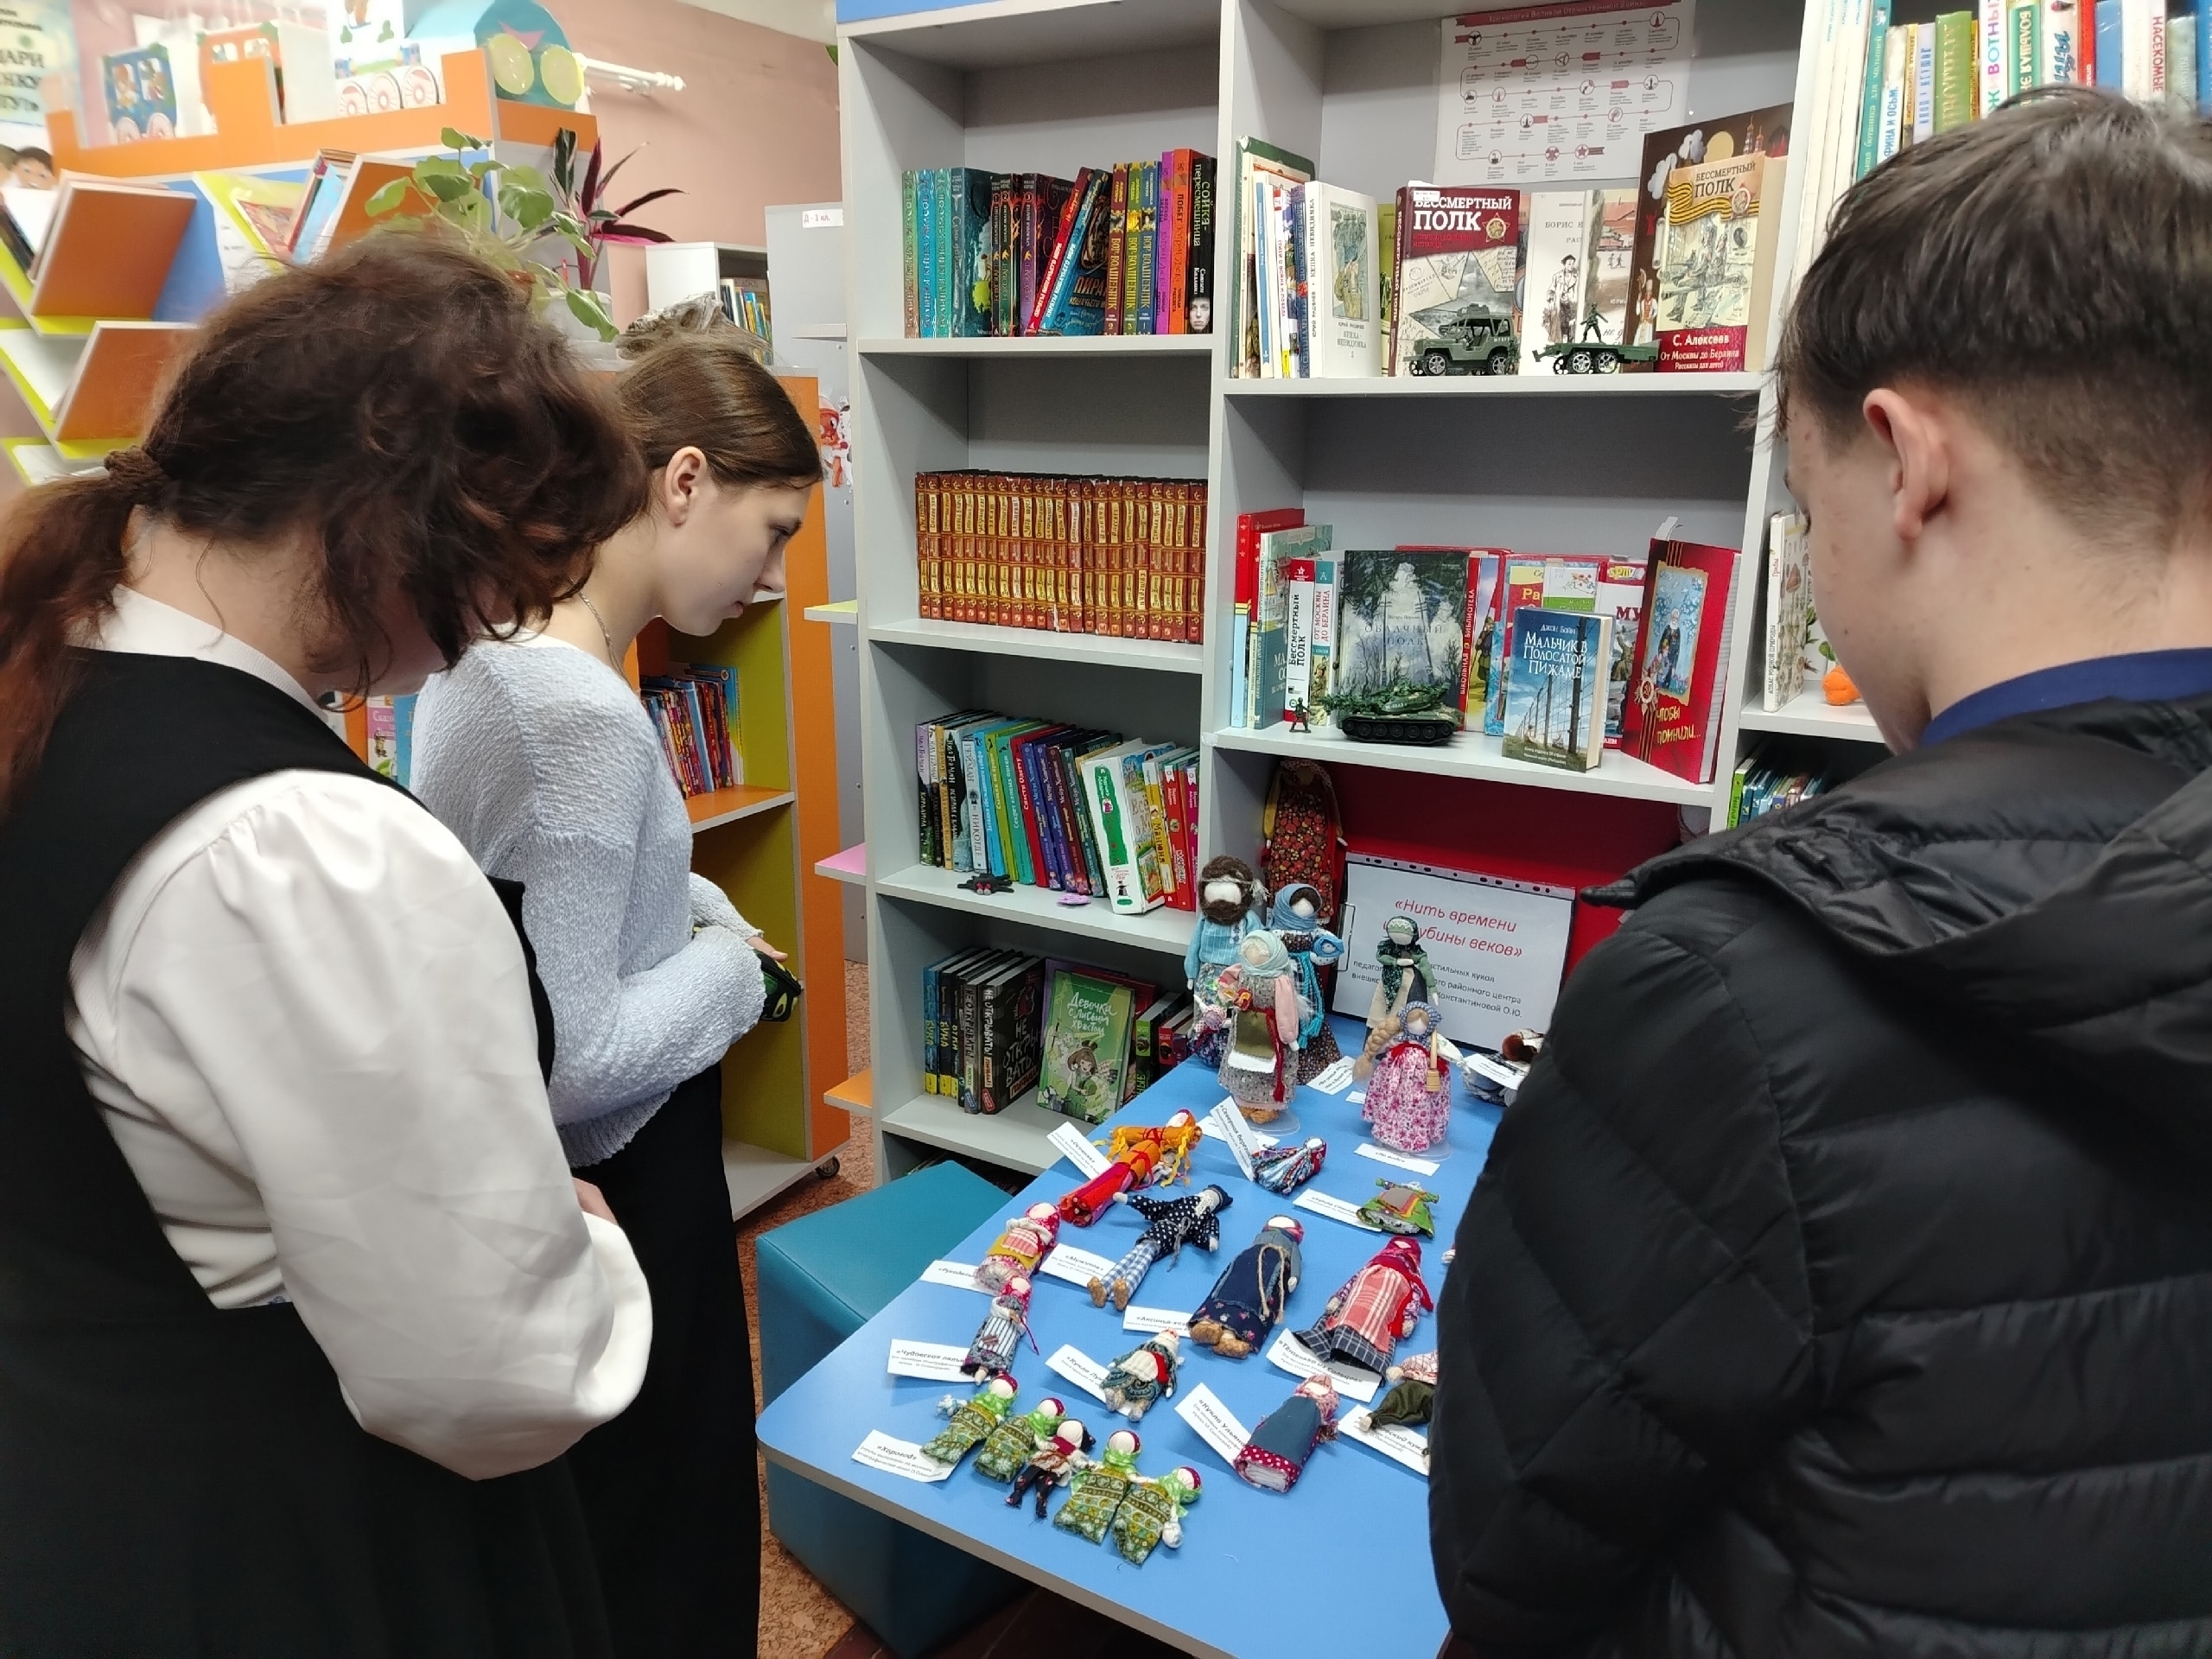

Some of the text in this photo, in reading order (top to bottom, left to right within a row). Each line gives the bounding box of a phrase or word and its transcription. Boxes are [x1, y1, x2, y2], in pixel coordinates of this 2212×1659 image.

[2152, 16, 2164, 93] НАСЕКОМЫЕ
[1696, 161, 1756, 182] БЕССМЕРТНЫЙ
[1694, 176, 1736, 198] ПОЛК
[1176, 194, 1185, 223] ПОБЕГ
[1413, 210, 1483, 232] ПОЛК
[1672, 334, 1729, 346] С. Алексеев
[1660, 352, 1671, 360] От
[1671, 350, 1699, 360] Москвы
[1710, 348, 1739, 361] Берлина
[1321, 590, 1331, 642] ДО БЕРЛИНА
[1464, 589, 1475, 638] БИБЛИОТЕКА
[1287, 593, 1300, 665] Бессмертный
[1313, 630, 1320, 640] ОТ
[1364, 624, 1442, 634] ОБЛАЧНЫЙ
[1387, 637, 1424, 645] ПОЛК
[1459, 652, 1468, 695] ШКОЛЬНАЯ
[1020, 785, 1029, 810] Спасти
[1395, 898, 1517, 933] «Нить времени
[1417, 926, 1522, 957] убины веков»
[1430, 963, 1496, 983] стильных кукол
[984, 988, 994, 1000] НЕ
[1067, 991, 1118, 1016] Девочка
[1447, 981, 1491, 998] районного
[1492, 989, 1522, 1005] центра
[1435, 992, 1523, 1019] Константиновой О.Ю.
[941, 1355, 965, 1363] ляльк
[876, 1444, 918, 1460] «Хоровод»
